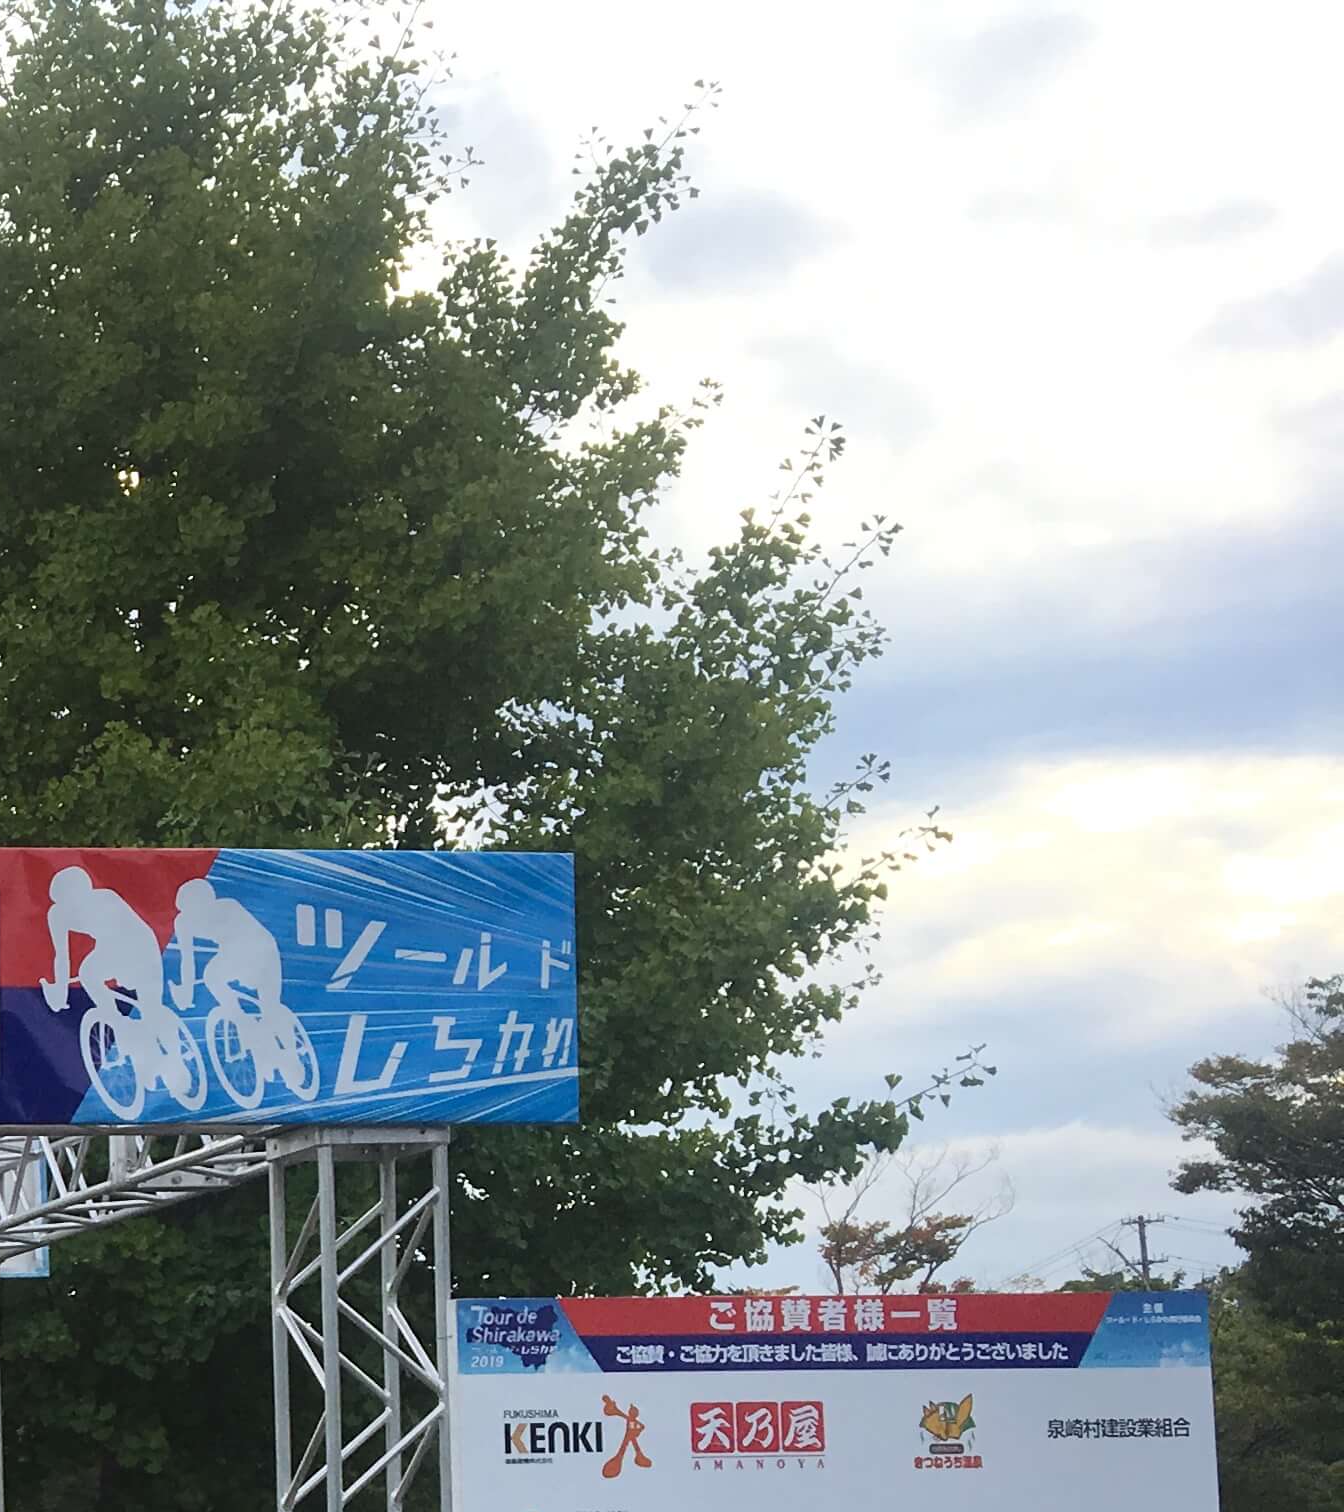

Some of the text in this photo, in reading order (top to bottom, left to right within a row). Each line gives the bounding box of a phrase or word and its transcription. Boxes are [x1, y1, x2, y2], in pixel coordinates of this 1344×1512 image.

[470, 1305, 537, 1325] Tour de
[709, 1298, 958, 1332] ご協賛者様一覧
[472, 1327, 560, 1343] Shirakawa
[471, 1356, 504, 1368] 2019
[504, 1409, 559, 1419] FUKUSHIMA
[694, 1405, 822, 1450] 天乃屋
[1047, 1417, 1190, 1439] 泉崎村建設業組合
[504, 1422, 603, 1454] KENKI
[694, 1459, 825, 1471] AMANOYA
